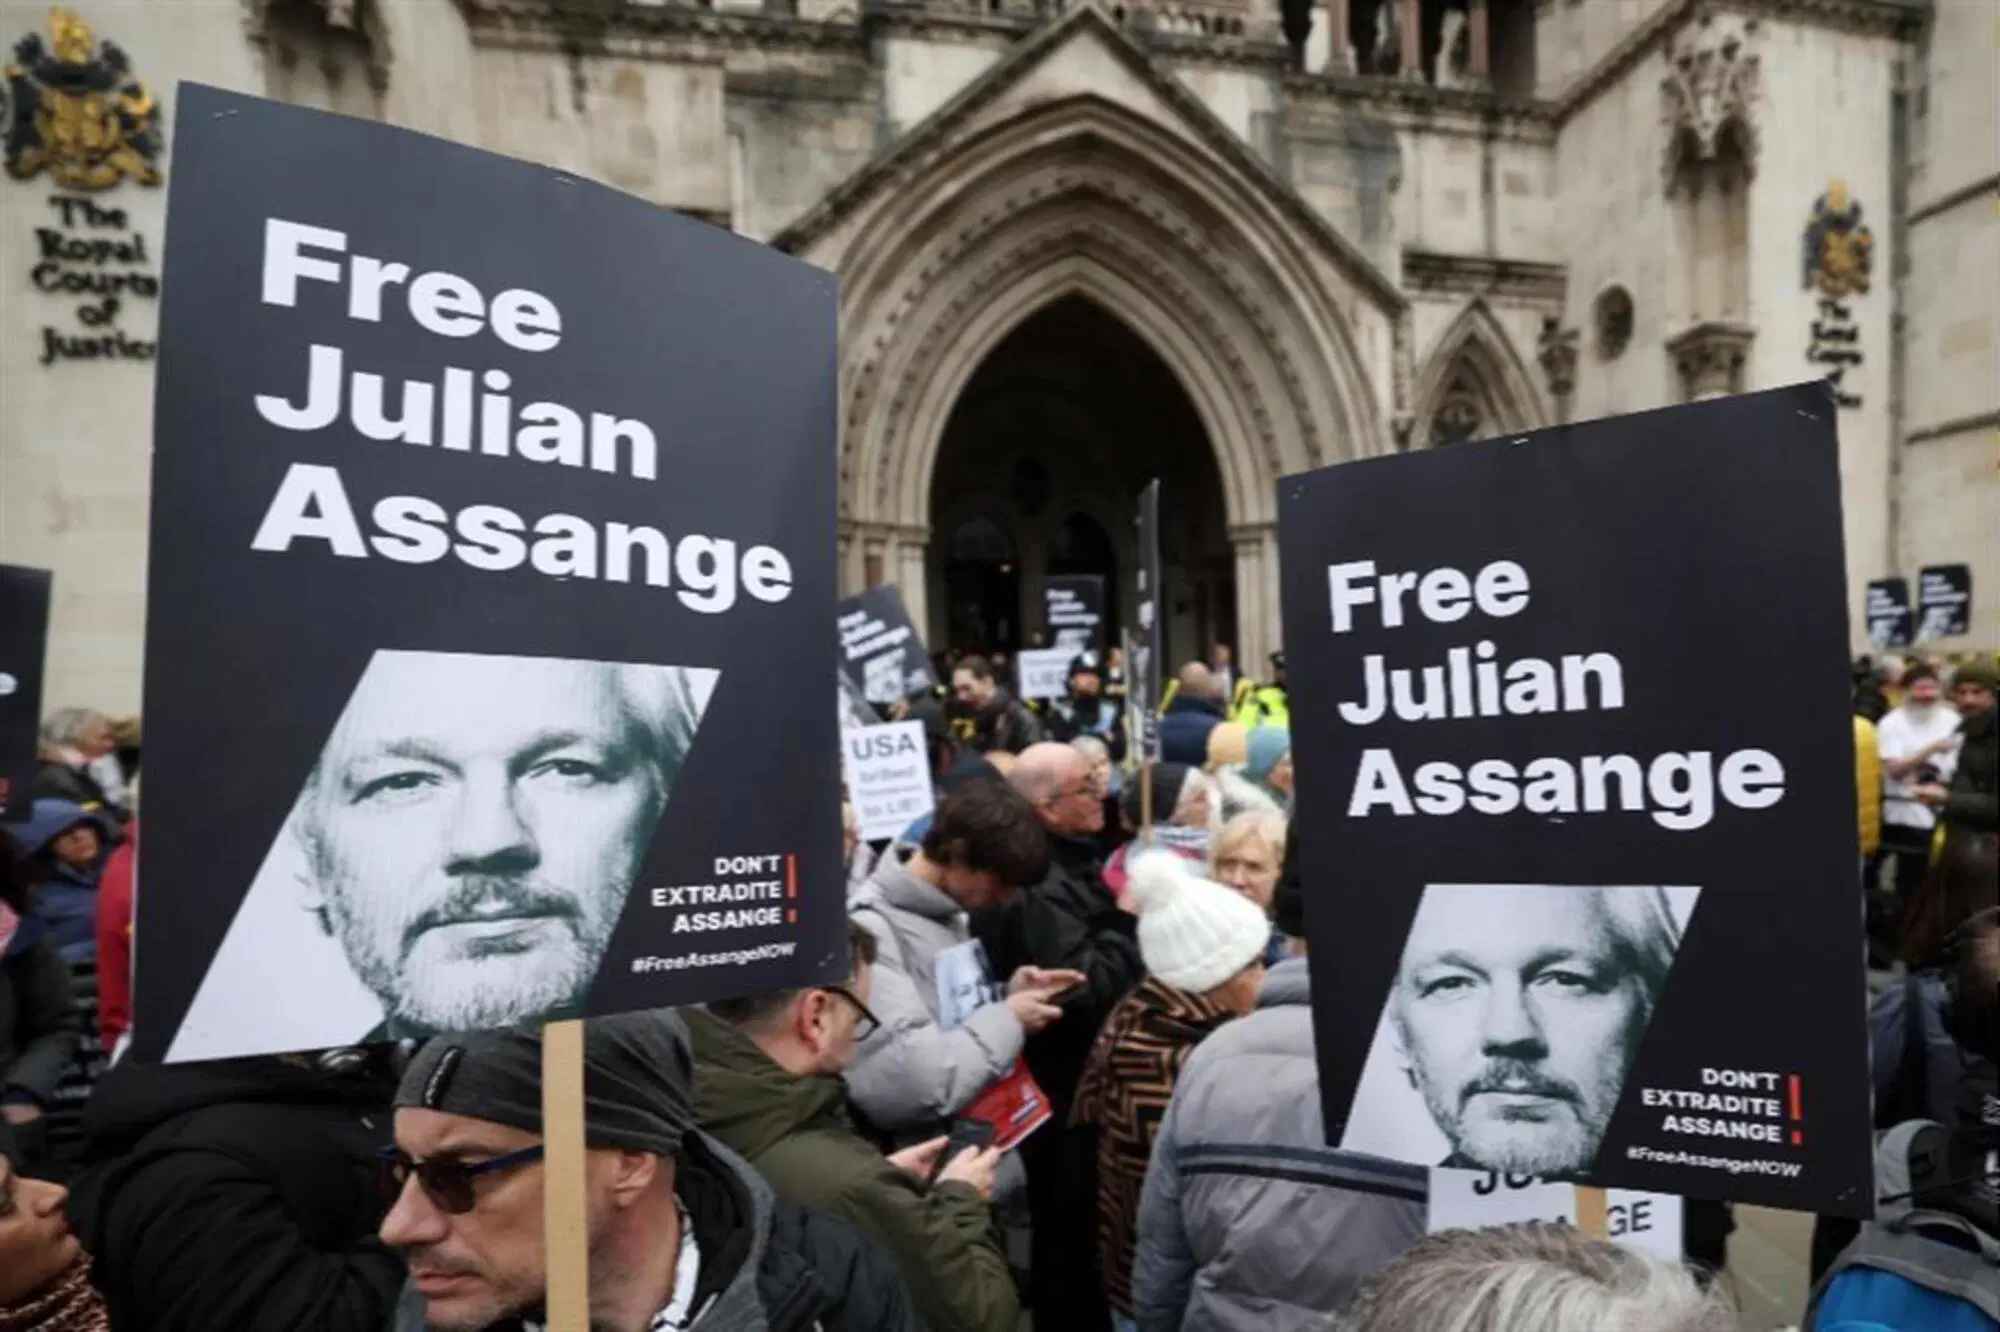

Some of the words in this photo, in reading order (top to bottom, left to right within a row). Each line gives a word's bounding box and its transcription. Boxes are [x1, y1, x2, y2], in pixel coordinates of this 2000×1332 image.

[48, 195, 127, 229] The
[35, 227, 147, 266] Royal
[261, 217, 562, 353] Free
[76, 298, 120, 327] of
[254, 343, 658, 481] Julian
[250, 462, 793, 614] Assange
[1328, 560, 1530, 633] Free
[1338, 640, 1624, 725] Julian
[851, 732, 917, 761] USA
[1347, 748, 1785, 830] Assange
[714, 854, 782, 876] DON'T
[651, 880, 782, 907] EXTRADITE
[671, 906, 782, 934] ASSANGE
[631, 941, 798, 973] #FreeAssangeNOW
[1701, 1067, 1780, 1091] DON'T
[1641, 1088, 1781, 1117] EXTRADITE
[1661, 1115, 1782, 1143] ASSANGE
[1626, 1146, 1803, 1178] #FreeAssangeNOW
